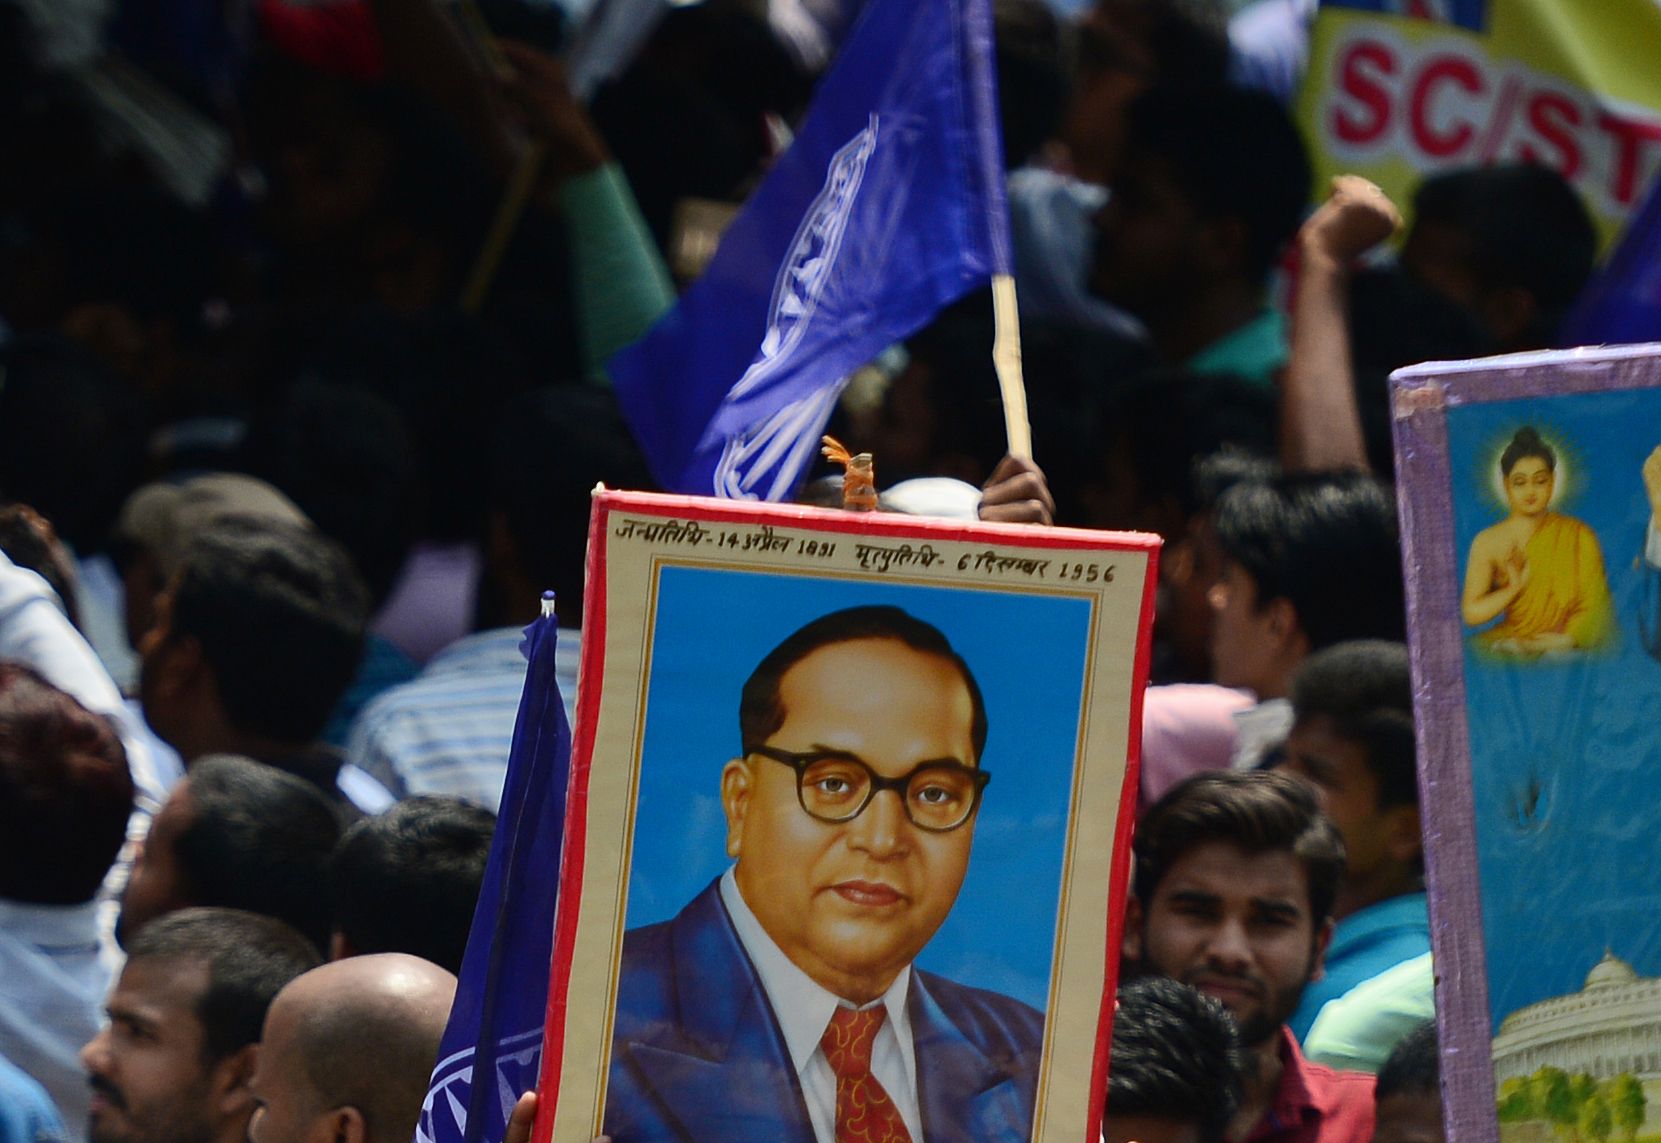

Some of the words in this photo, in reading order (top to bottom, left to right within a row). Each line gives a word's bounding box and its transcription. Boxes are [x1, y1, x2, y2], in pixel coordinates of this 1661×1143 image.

[797, 539, 837, 557] 1891
[957, 554, 971, 570] 6
[1058, 562, 1118, 583] 1956
